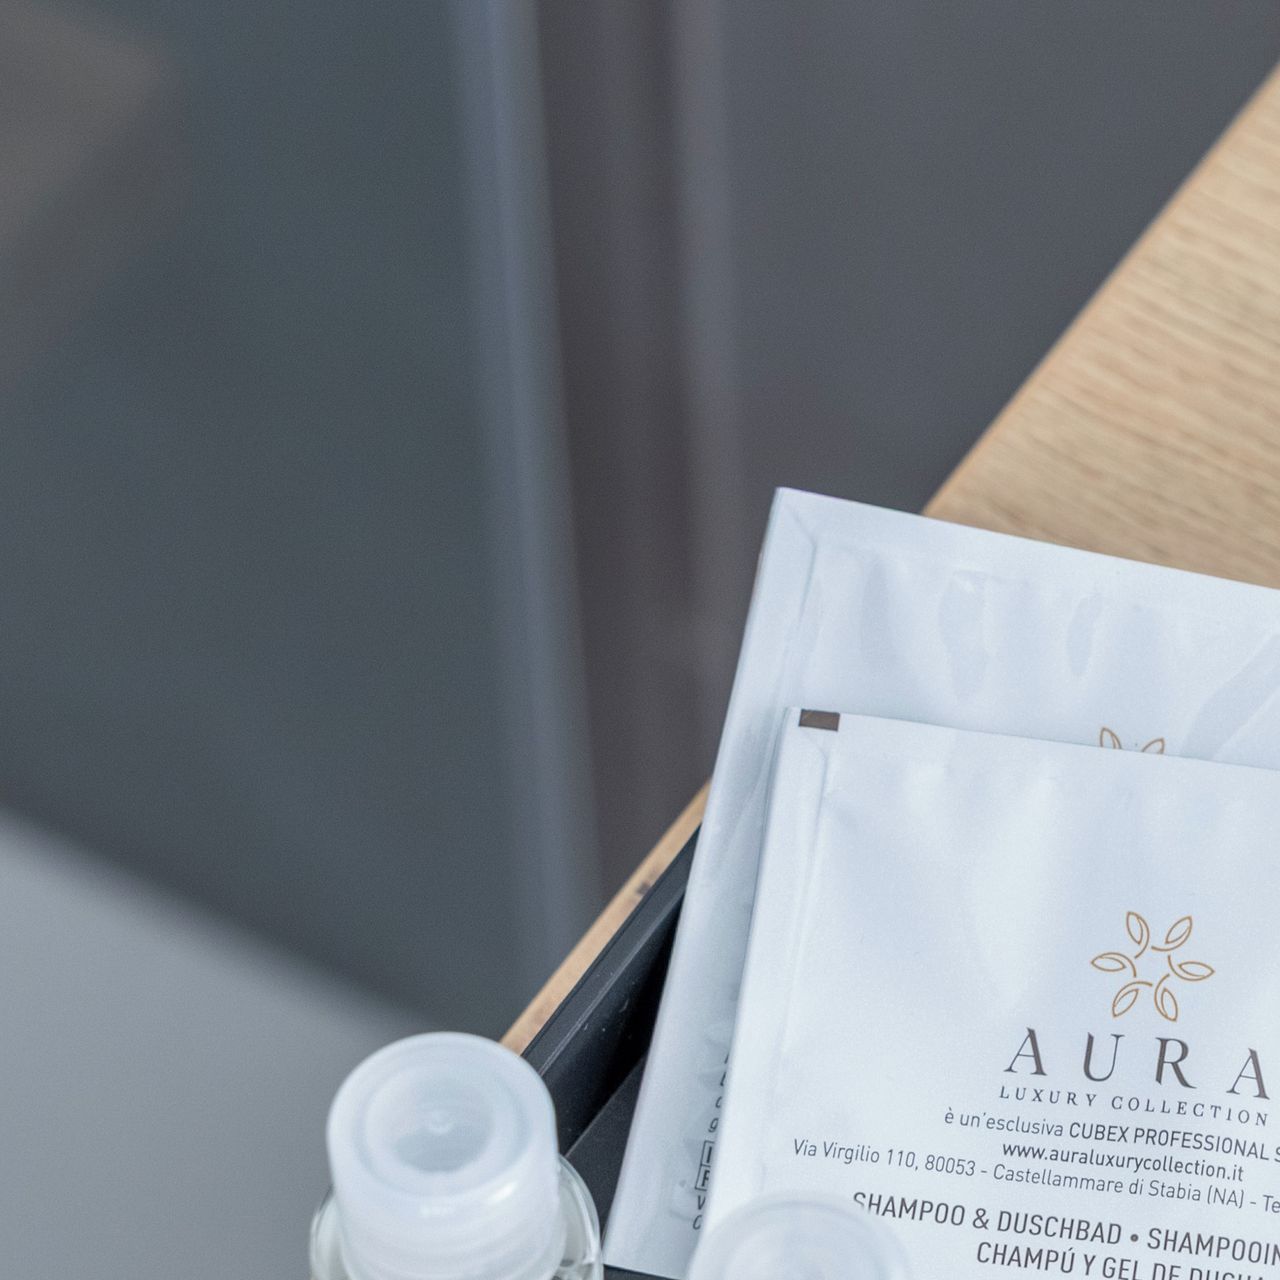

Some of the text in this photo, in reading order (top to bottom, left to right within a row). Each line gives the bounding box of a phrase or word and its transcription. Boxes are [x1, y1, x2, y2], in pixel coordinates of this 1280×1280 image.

[1003, 1026, 1271, 1100] AURA
[999, 1085, 1270, 1127] LUXURY COLLECTION
[944, 1107, 954, 1124] è
[959, 1111, 1064, 1137] un'esclusiva
[1068, 1122, 1129, 1143] CUBEX
[1133, 1127, 1270, 1160] PROFESSIONAL
[793, 1138, 818, 1157] Via
[823, 1141, 880, 1164] Virgilio
[886, 1148, 919, 1171] 110,
[925, 1154, 976, 1177] 80053
[993, 1163, 1124, 1193] Castellammare
[1129, 1178, 1144, 1197] di
[1148, 1179, 1202, 1202] Stabia
[1206, 1184, 1245, 1209] (NA)
[1002, 1143, 1245, 1182] www.auraluxurycollection.it
[853, 1192, 965, 1226] SHAMPOO
[972, 1207, 991, 1231] &
[997, 1210, 1122, 1246] DUSCHBAD
[976, 1241, 1075, 1274] CHAMPÚ
[1084, 1253, 1096, 1276] Y
